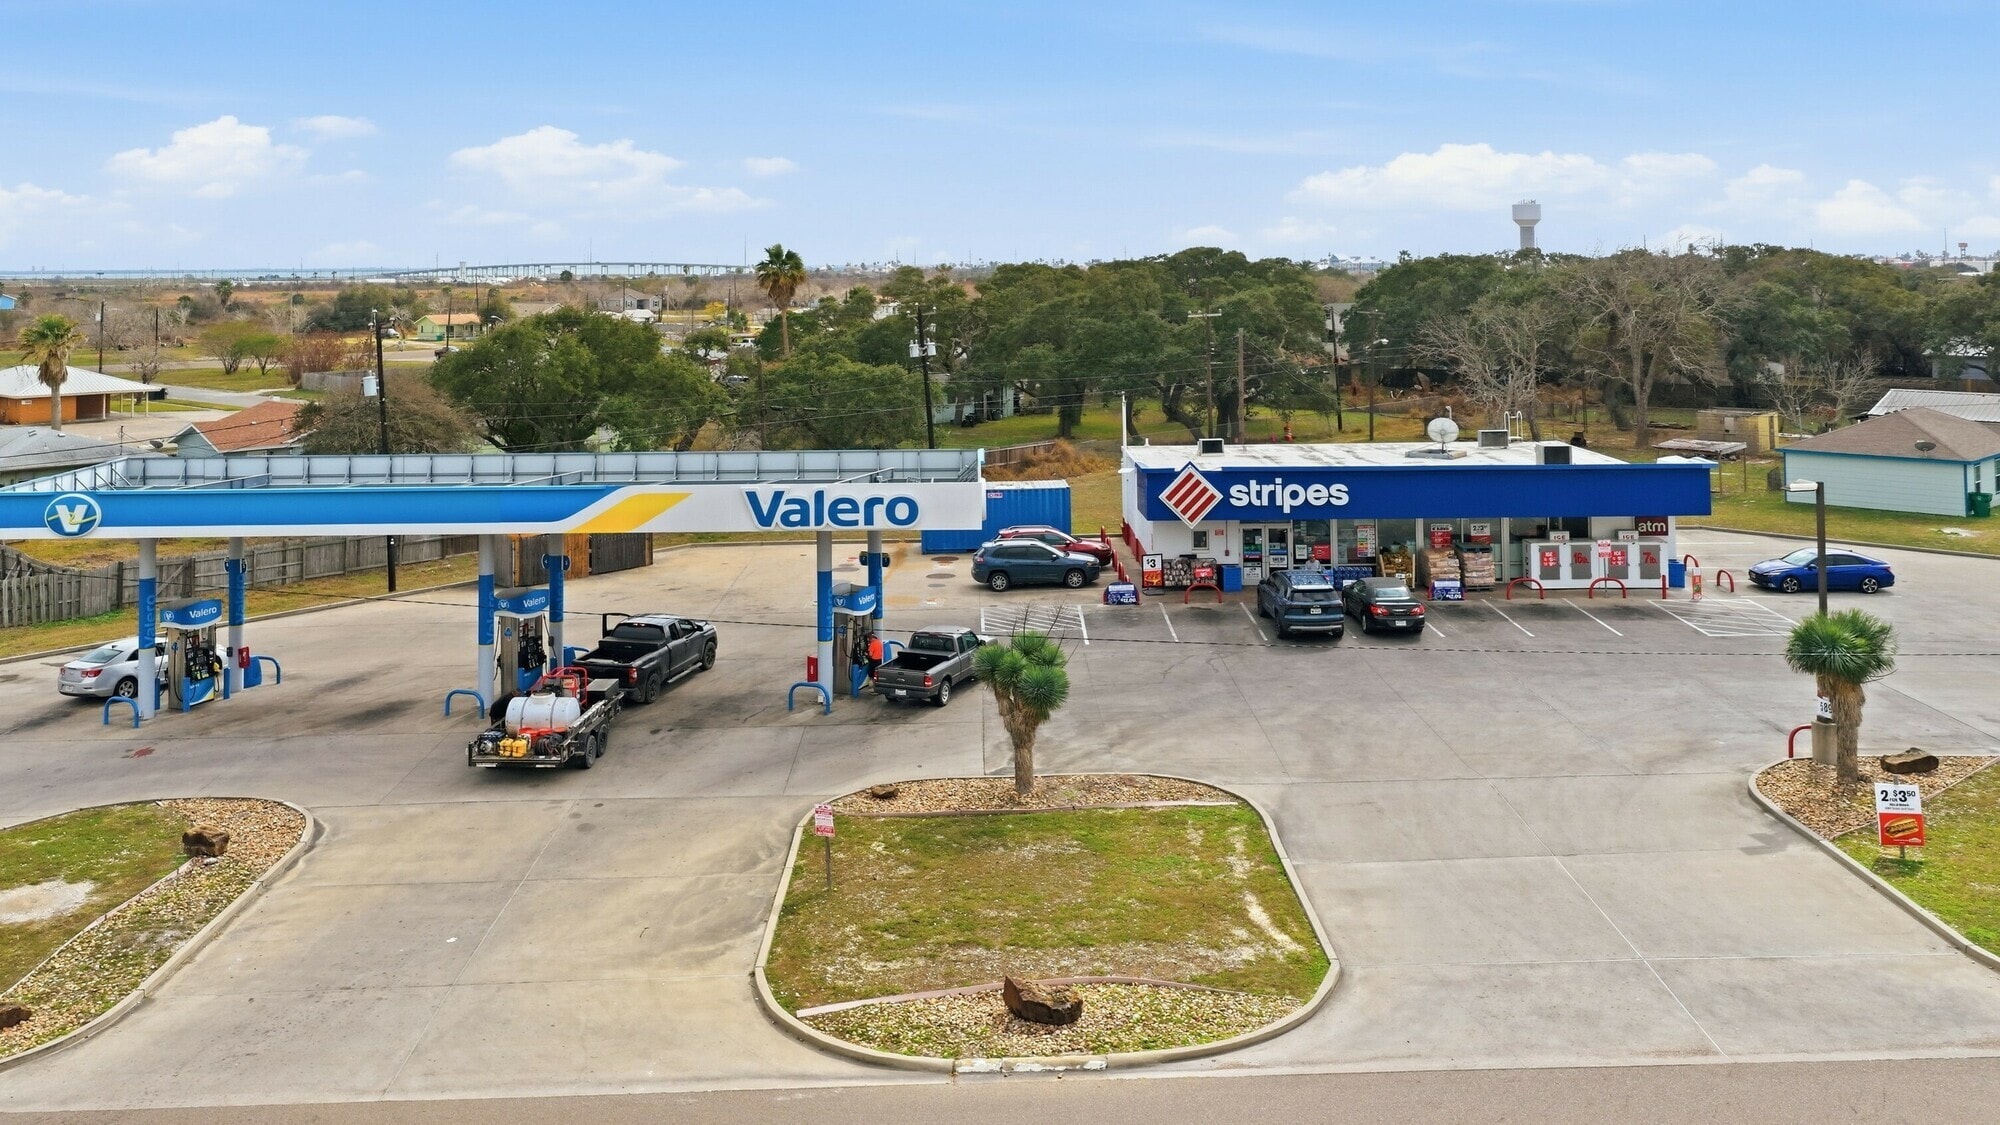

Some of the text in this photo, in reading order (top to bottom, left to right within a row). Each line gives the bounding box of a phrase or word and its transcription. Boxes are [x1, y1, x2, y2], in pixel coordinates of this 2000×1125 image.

[1229, 477, 1350, 514] stripes
[745, 489, 919, 528] Valero
[1638, 520, 1666, 532] atm
[1146, 558, 1156, 569] $3
[523, 595, 546, 608] Valero
[189, 605, 217, 620] Valero
[144, 594, 156, 649] Valero
[1880, 789, 1889, 802] 2
